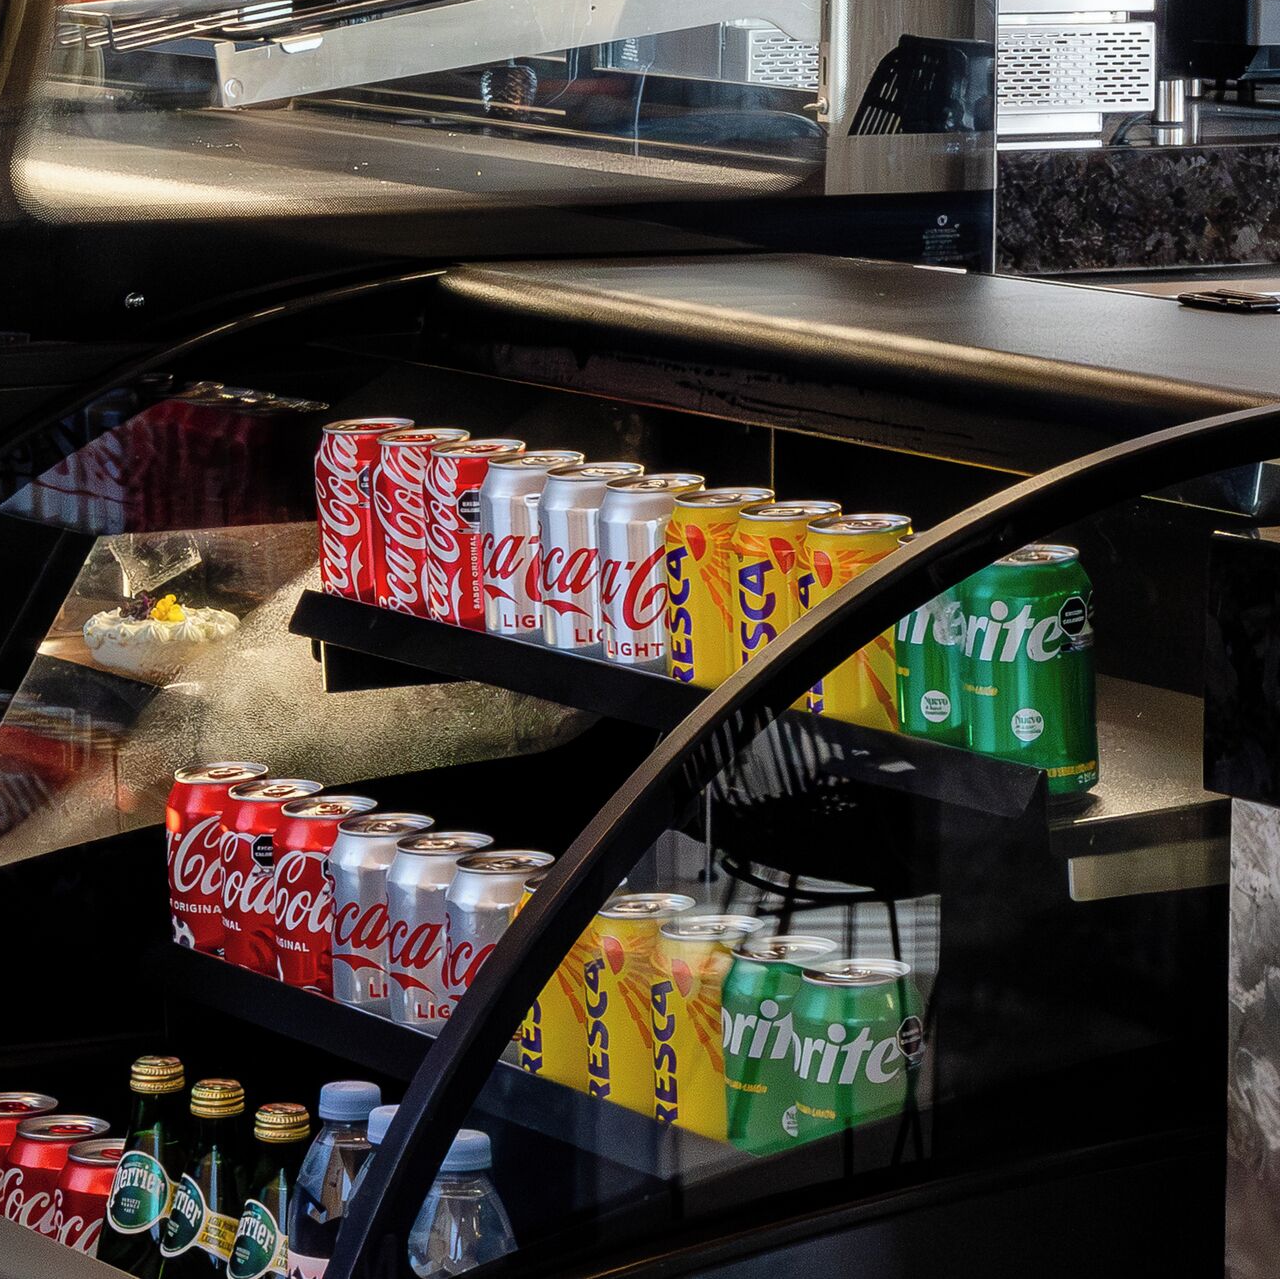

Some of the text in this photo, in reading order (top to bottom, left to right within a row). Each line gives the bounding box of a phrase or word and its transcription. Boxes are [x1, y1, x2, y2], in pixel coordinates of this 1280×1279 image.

[471, 535, 481, 610] SABOR ORIGINAL
[503, 613, 543, 628] LIG
[608, 640, 664, 657] LIGHT
